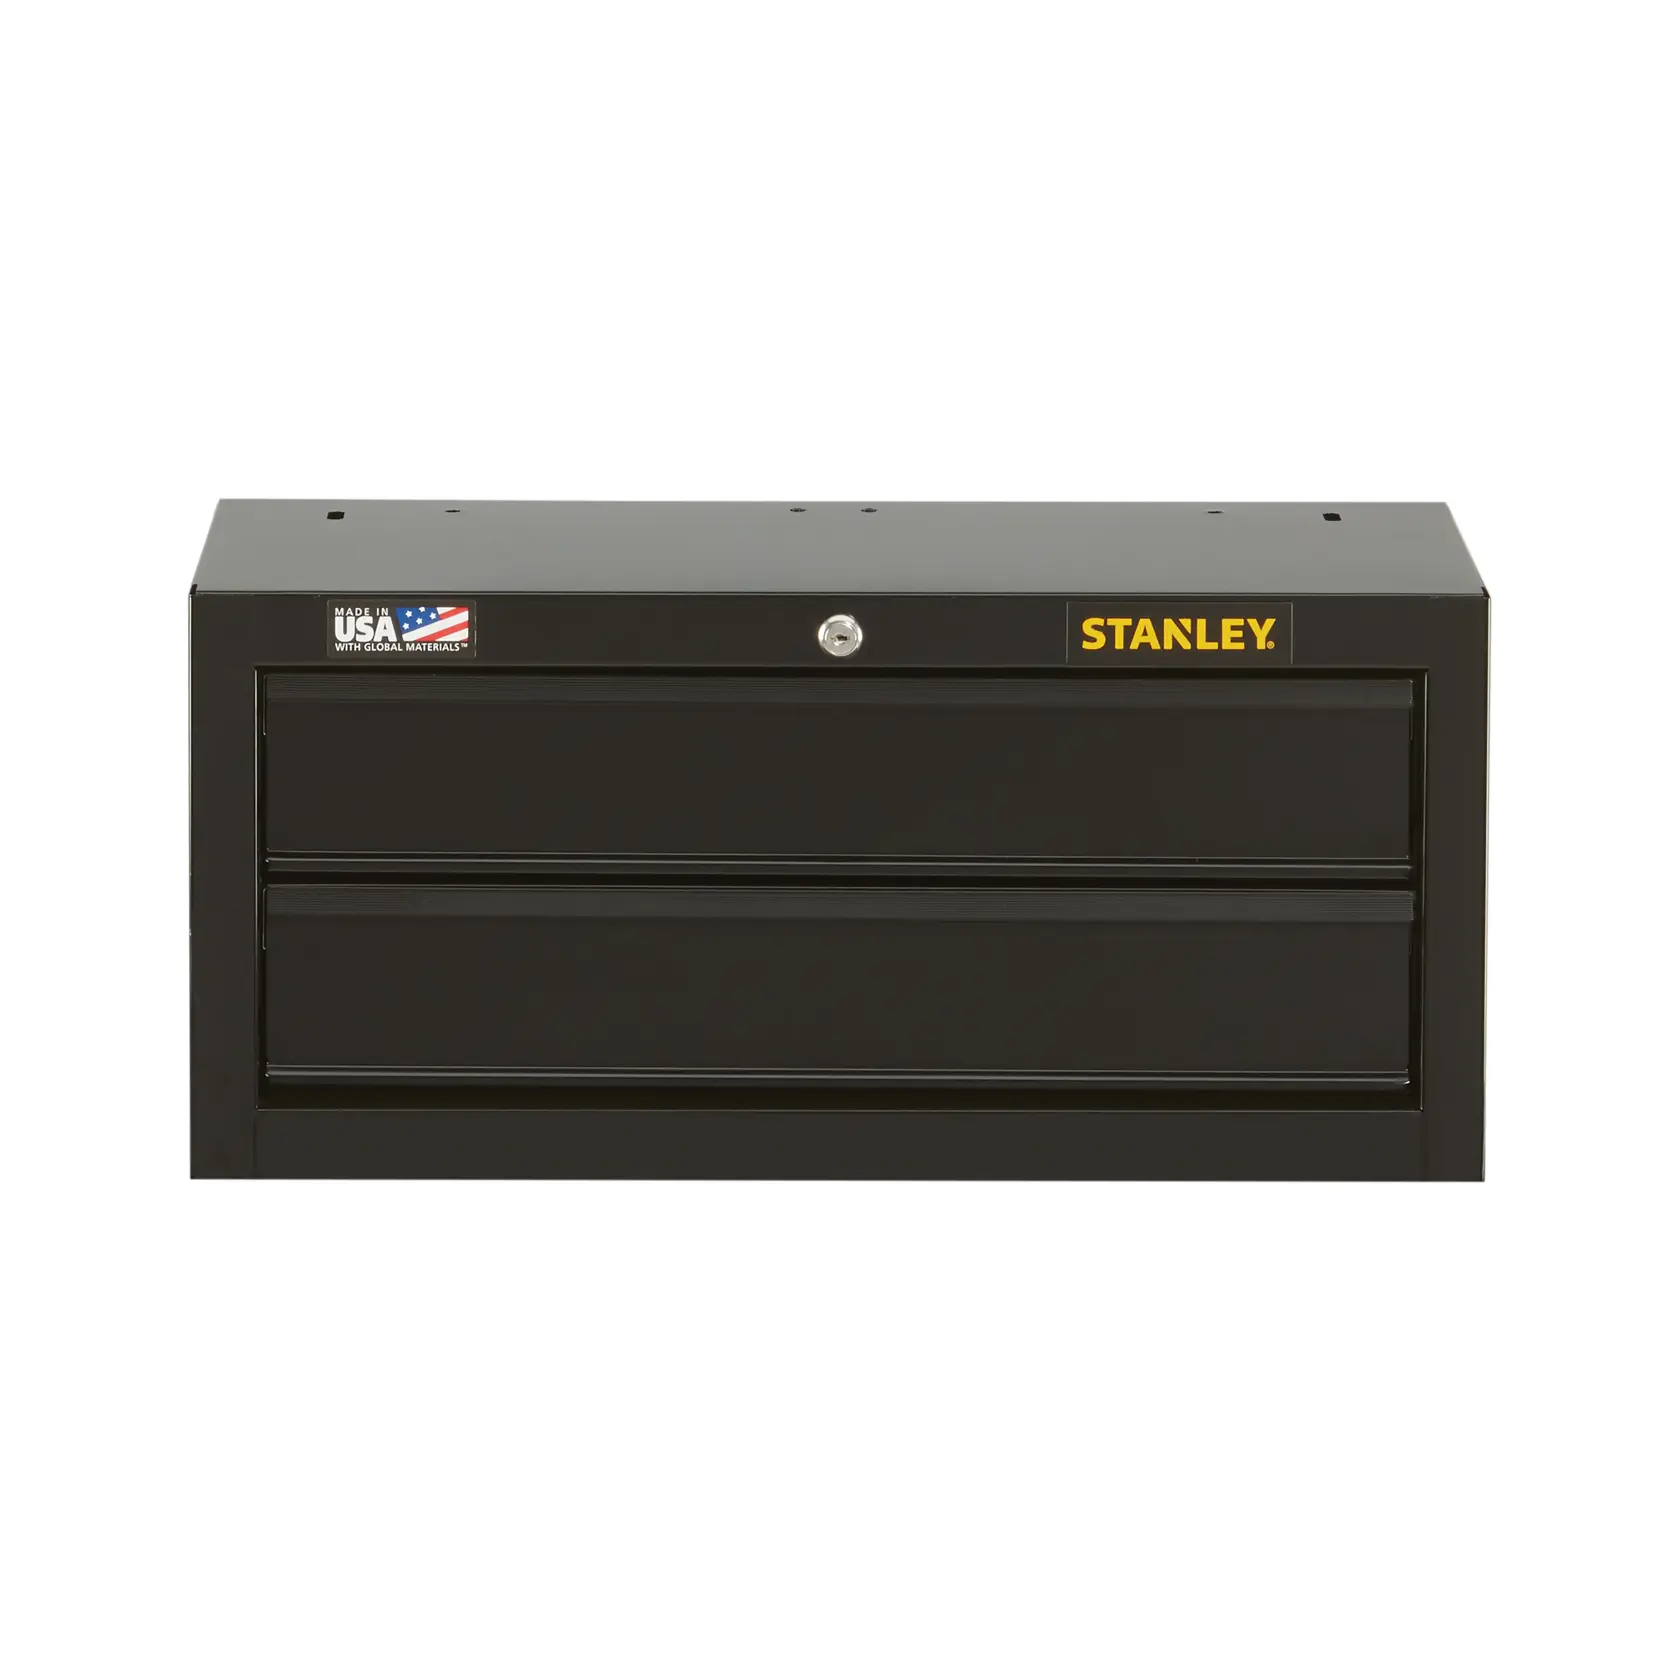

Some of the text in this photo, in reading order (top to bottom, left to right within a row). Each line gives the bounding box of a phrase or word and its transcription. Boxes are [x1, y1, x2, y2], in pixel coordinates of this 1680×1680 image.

[335, 607, 389, 616] MADE IN
[334, 616, 398, 643] USA
[335, 643, 361, 652] WITH
[364, 643, 403, 652] GLOBAL
